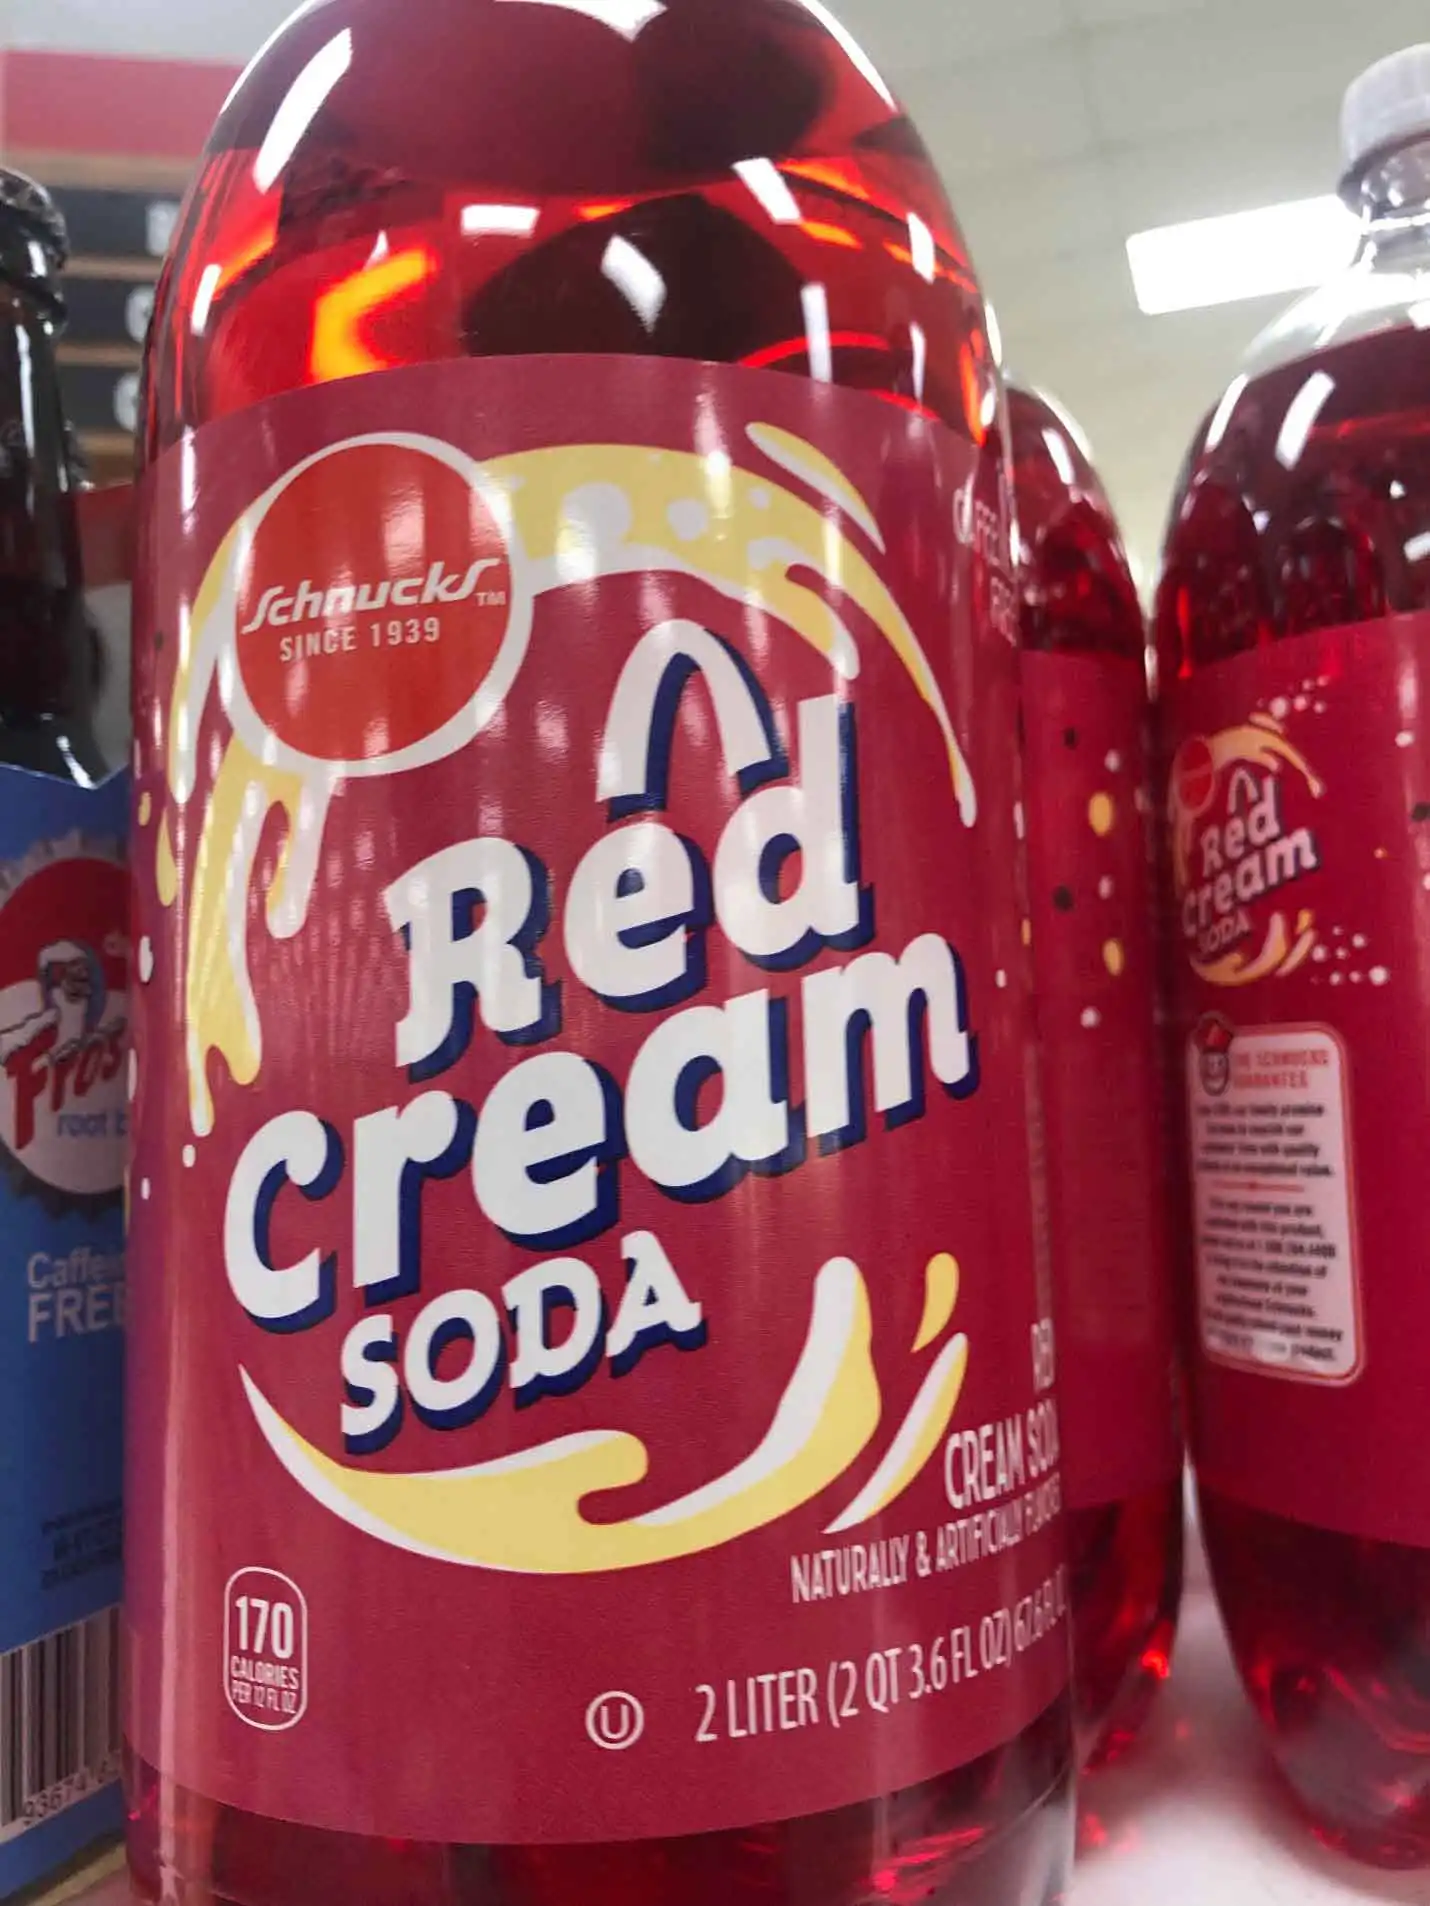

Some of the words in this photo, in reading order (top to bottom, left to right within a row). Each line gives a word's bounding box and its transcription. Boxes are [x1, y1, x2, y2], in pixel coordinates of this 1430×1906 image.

[241, 557, 500, 634] Schnucks
[280, 626, 358, 662] SINCE
[370, 617, 441, 647] 1939
[1200, 775, 1281, 878] Red
[384, 694, 870, 1078] Red
[1181, 828, 1319, 937] Cream
[225, 933, 976, 1326] Cream
[341, 1231, 706, 1450] SODA
[945, 1413, 1026, 1510] CREAM
[791, 1534, 909, 1603] NATURALLY
[915, 1530, 932, 1578] &
[231, 1655, 300, 1690] CALORIES
[235, 1596, 294, 1659] 170
[695, 1684, 717, 1742] 2
[727, 1667, 819, 1738] LITER
[827, 1661, 858, 1728] (2
[865, 1648, 902, 1713] QT
[909, 1637, 947, 1699] 3.6
[951, 1625, 977, 1683] FL
[979, 1607, 1012, 1669] OZ)
